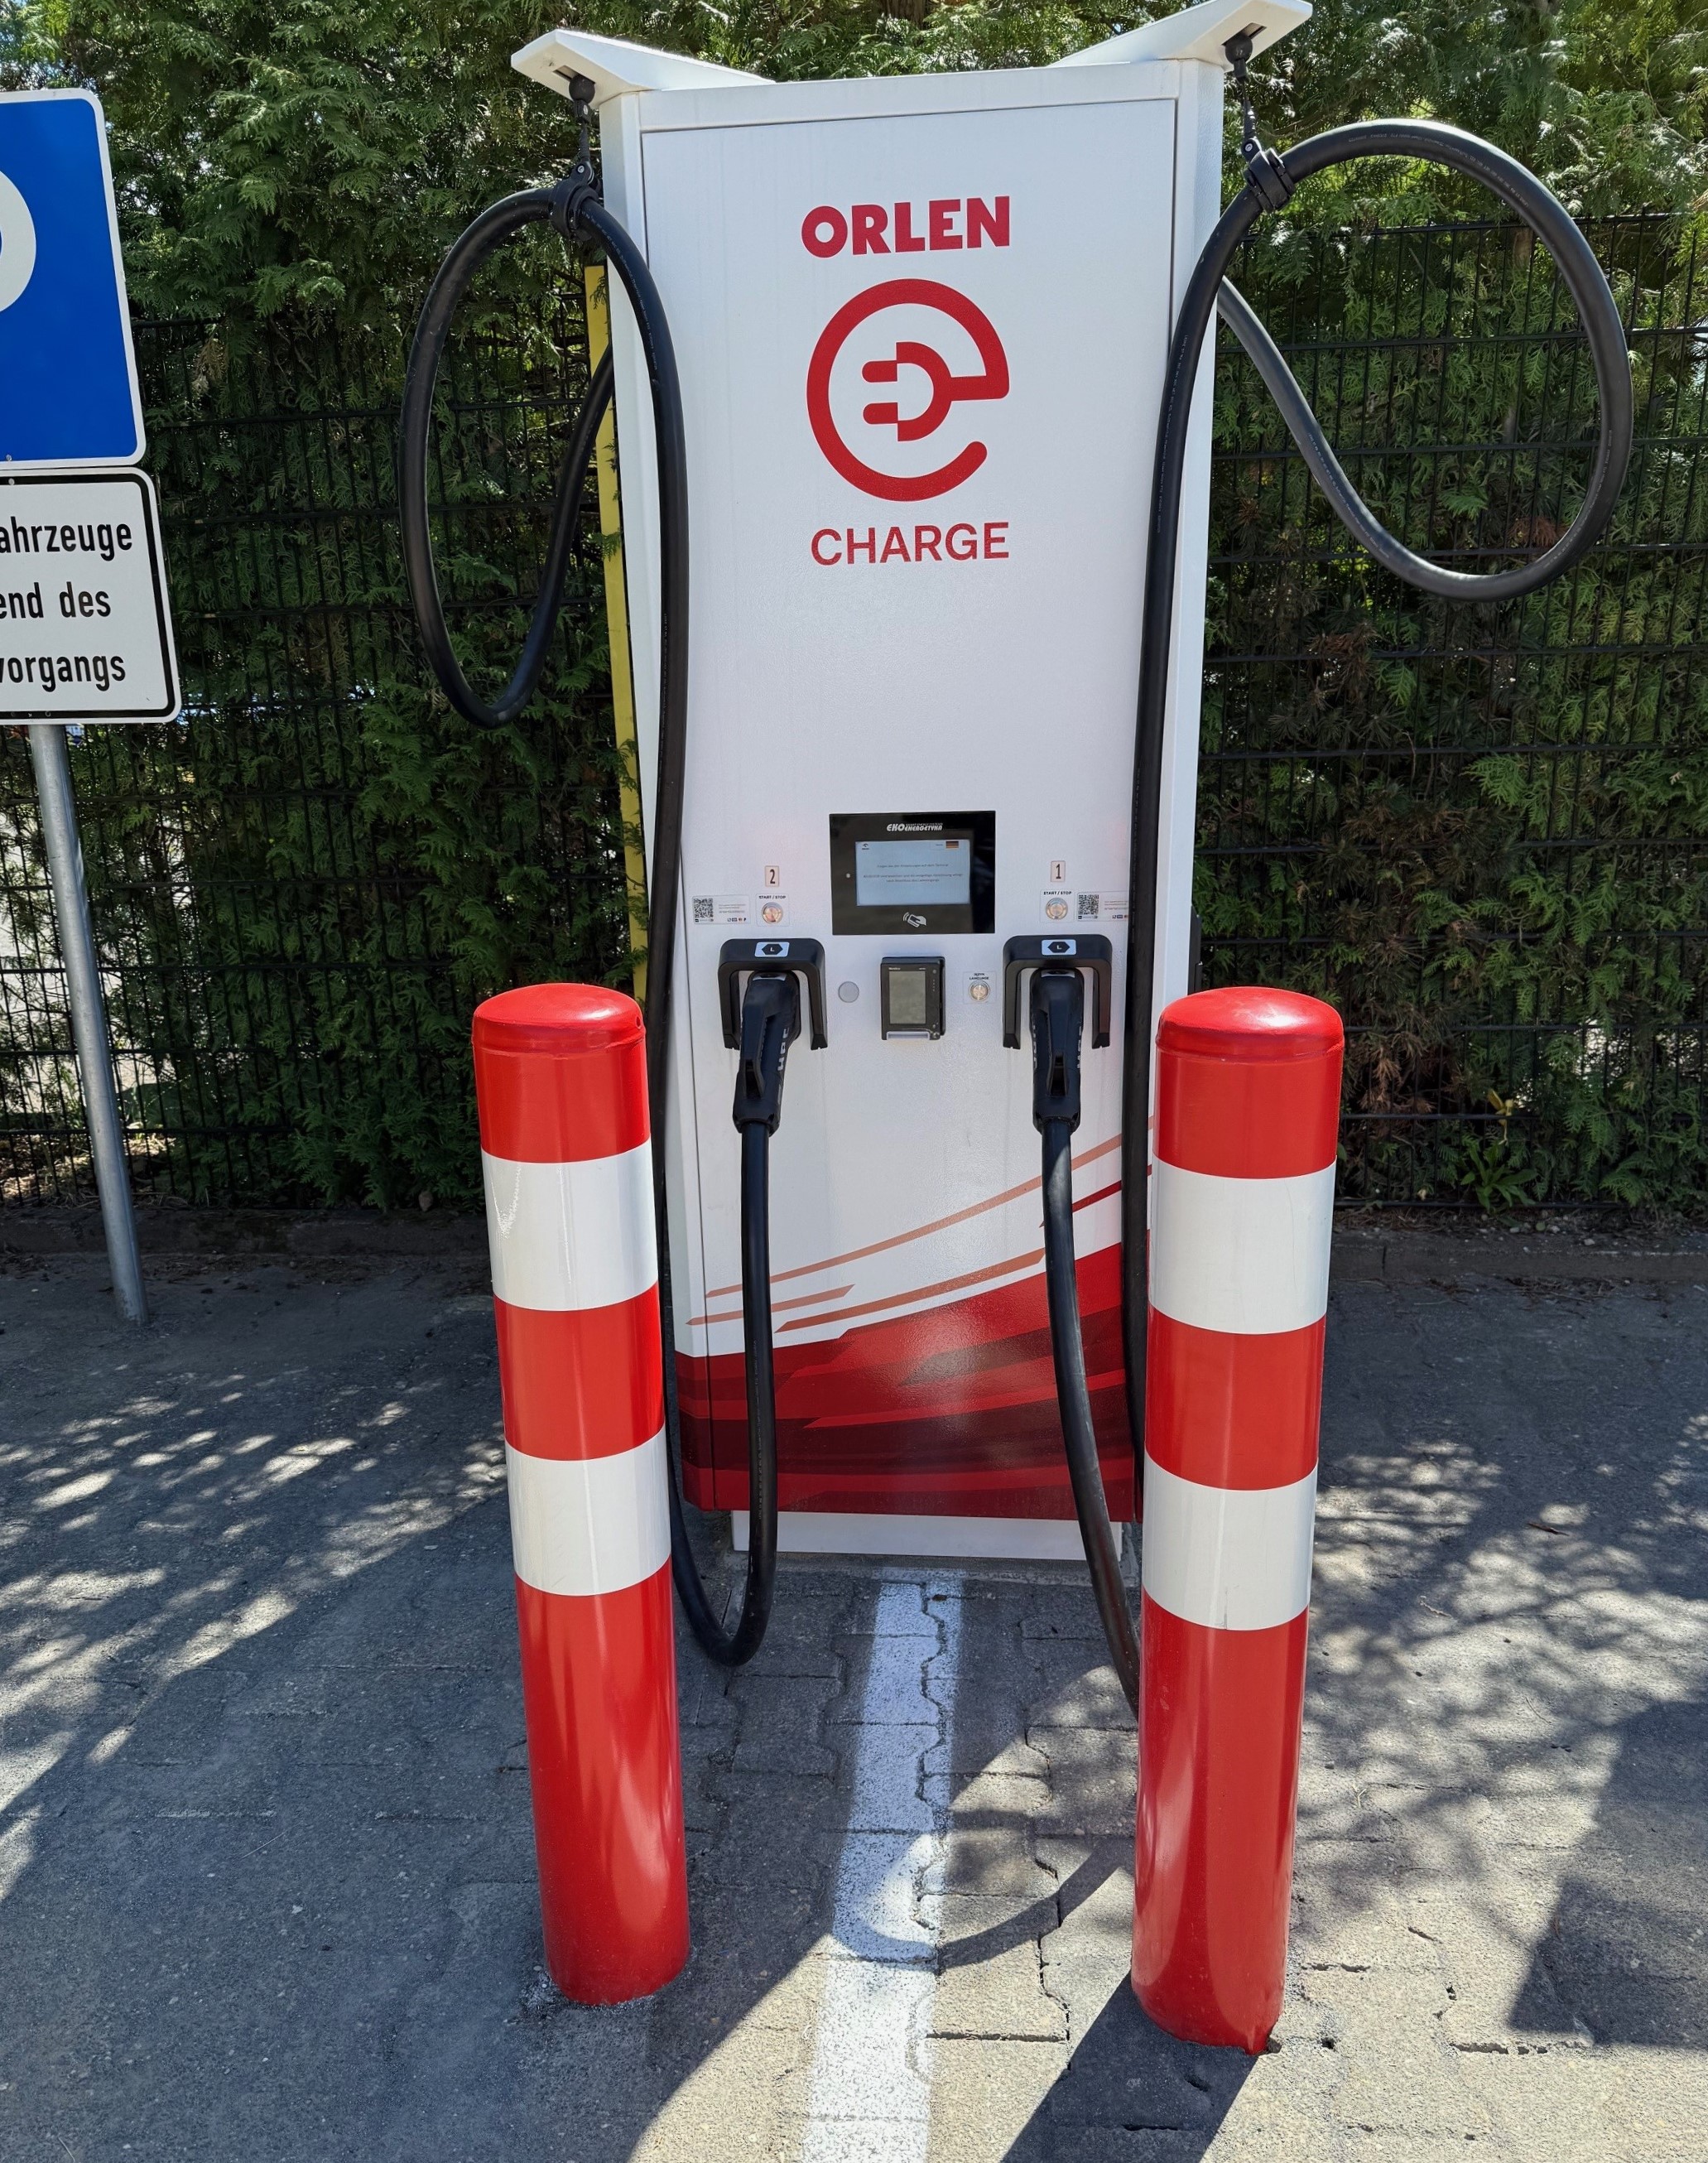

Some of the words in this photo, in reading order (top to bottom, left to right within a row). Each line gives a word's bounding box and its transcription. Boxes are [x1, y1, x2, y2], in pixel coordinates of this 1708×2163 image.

[801, 195, 1010, 258] ORLEN
[811, 522, 1009, 566] CHARGE
[59, 581, 111, 618] des
[769, 869, 776, 884] 2
[1056, 863, 1061, 879] 1
